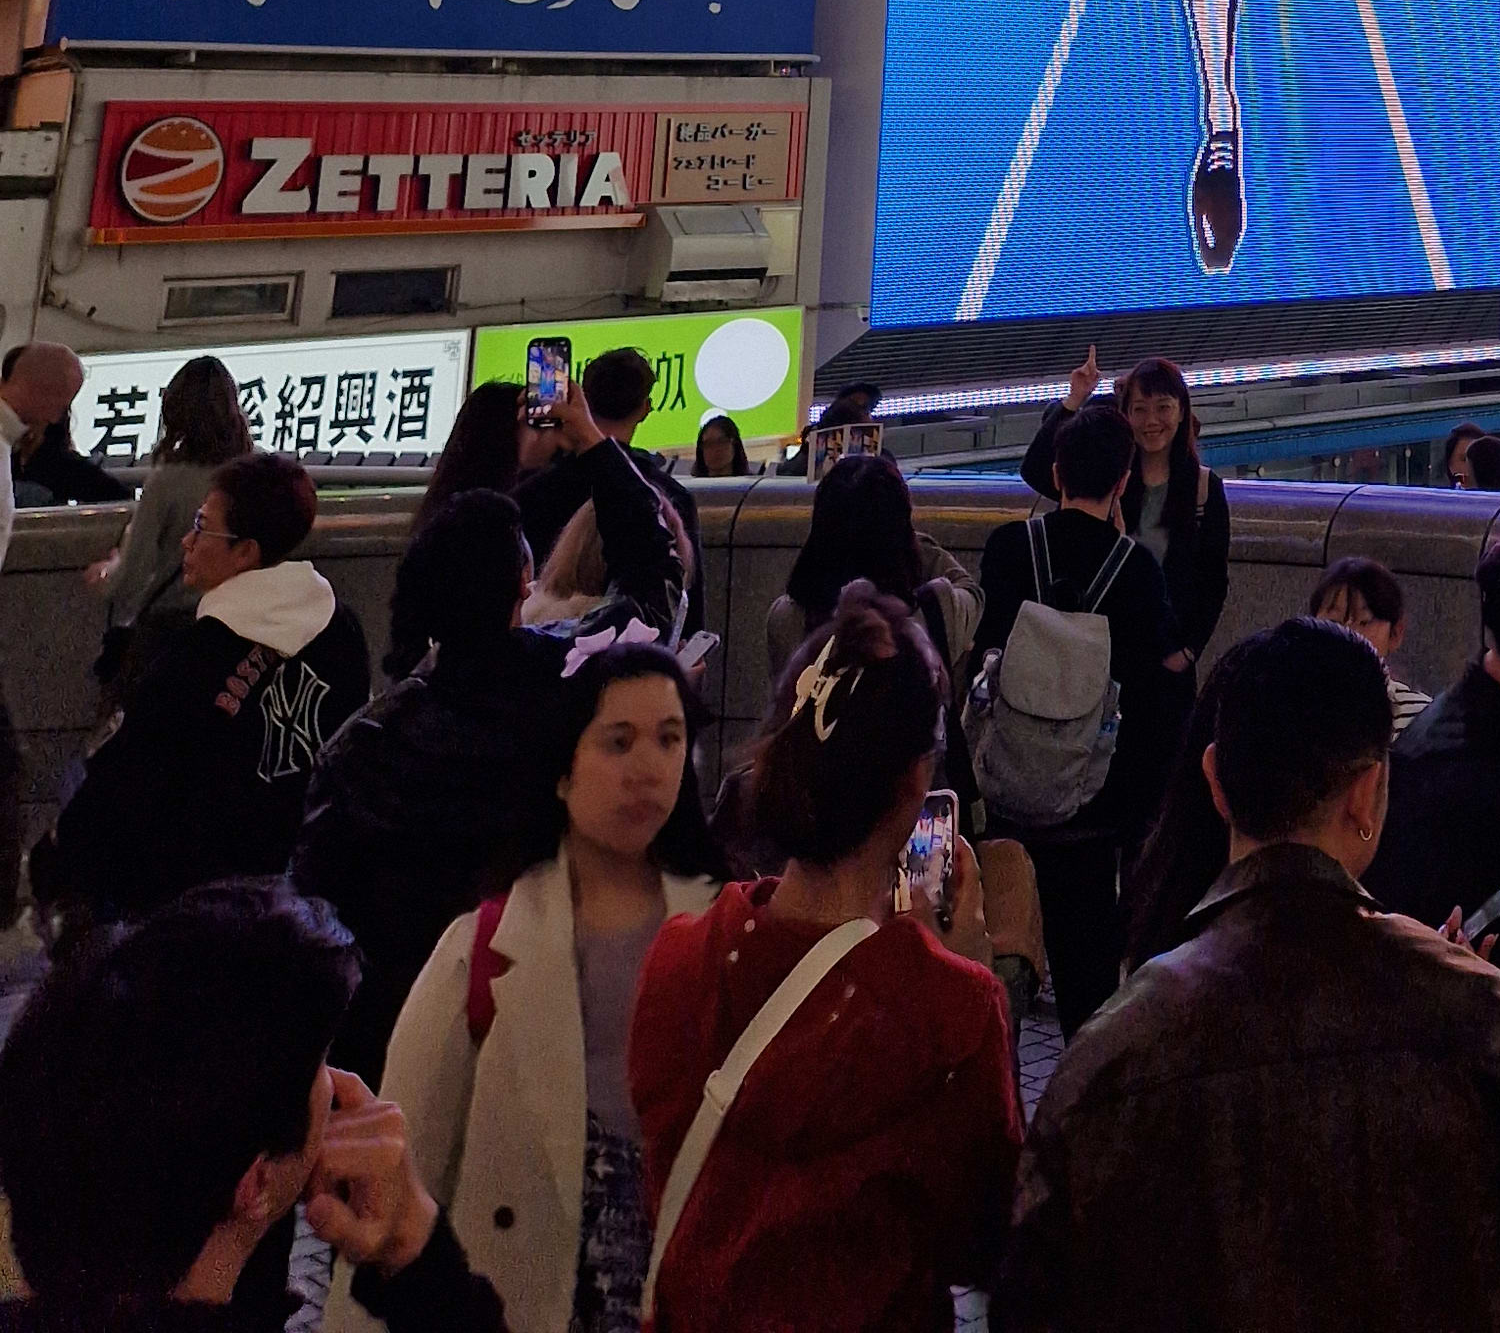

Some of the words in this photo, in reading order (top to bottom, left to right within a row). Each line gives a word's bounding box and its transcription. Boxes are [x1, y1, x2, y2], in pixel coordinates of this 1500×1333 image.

[515, 129, 598, 148] ゼッテリア
[242, 137, 631, 214] ZETTERIA
[707, 174, 775, 191] コーヒー
